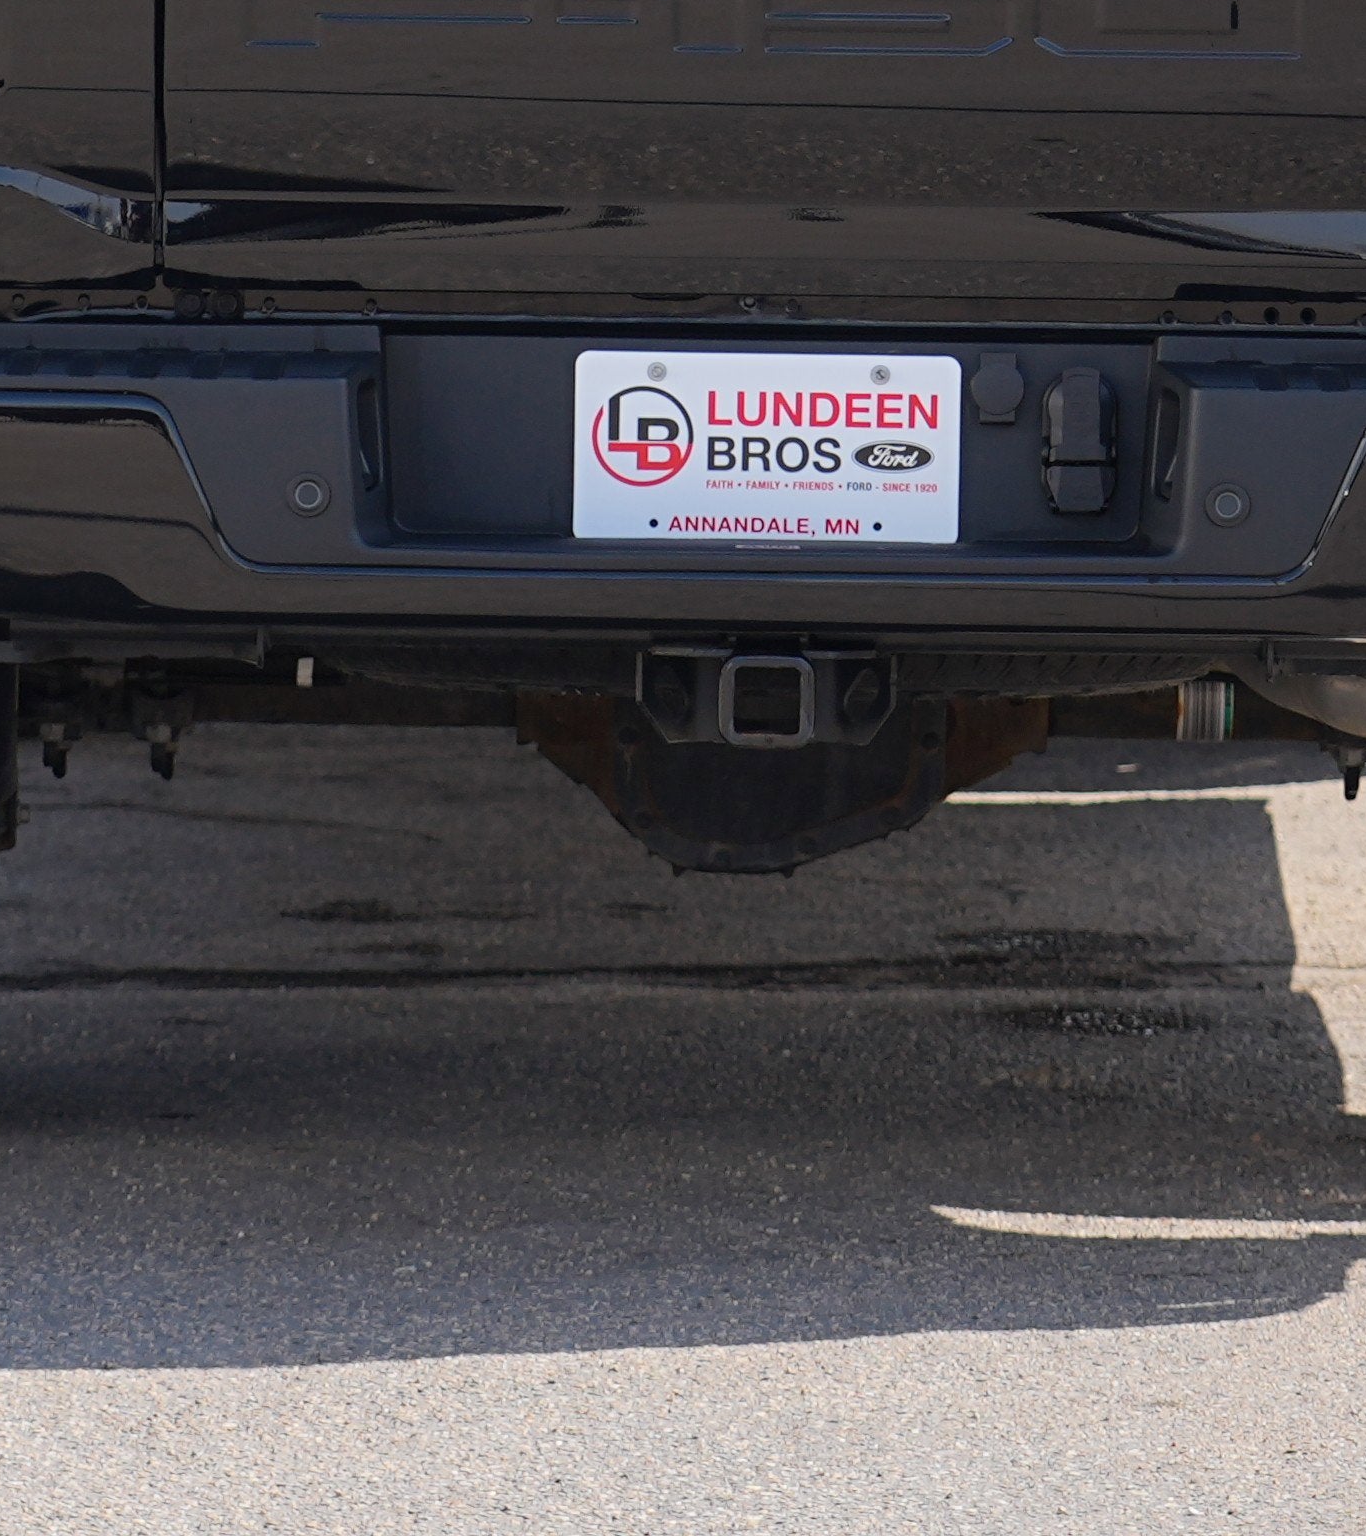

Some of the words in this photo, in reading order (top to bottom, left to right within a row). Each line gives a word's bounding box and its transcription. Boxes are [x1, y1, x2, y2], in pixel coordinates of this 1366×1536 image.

[707, 390, 938, 430] LUNDEEN
[706, 436, 842, 474] BROS
[866, 444, 919, 469] Ford
[705, 480, 734, 490] FAITH
[745, 480, 780, 491] FAMILY
[792, 482, 834, 492] FRIENDS
[846, 482, 872, 492] FORD
[881, 483, 911, 493] SINCE
[915, 483, 938, 494] 1920
[668, 516, 815, 537] ANNANDALE,
[825, 518, 860, 535] MN
